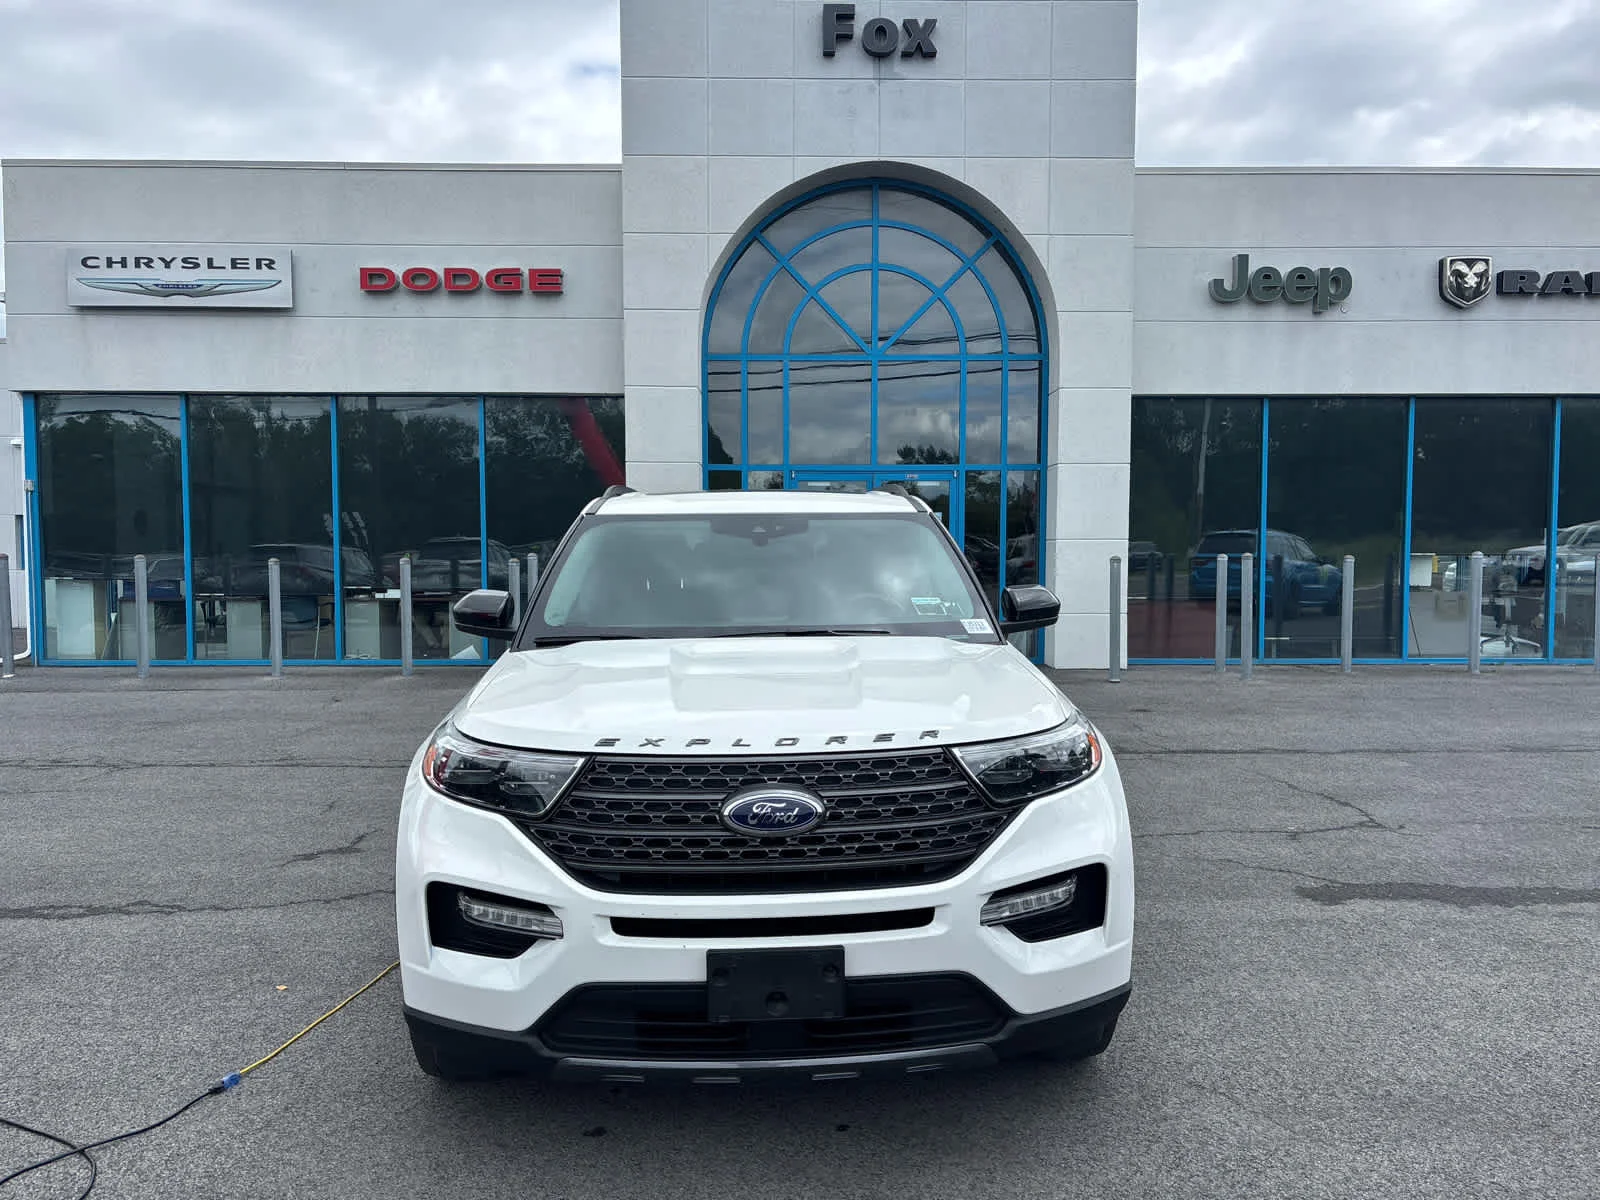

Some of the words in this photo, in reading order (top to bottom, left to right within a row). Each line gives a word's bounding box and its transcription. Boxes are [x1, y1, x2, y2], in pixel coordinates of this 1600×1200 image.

[822, 3, 938, 57] Fox
[80, 256, 276, 270] CHRYSLER
[360, 267, 564, 293] DODGE
[1208, 253, 1353, 314] Jeep
[1496, 269, 1600, 296] RA
[594, 729, 940, 748] EXPLORER
[747, 802, 799, 825] Ford
